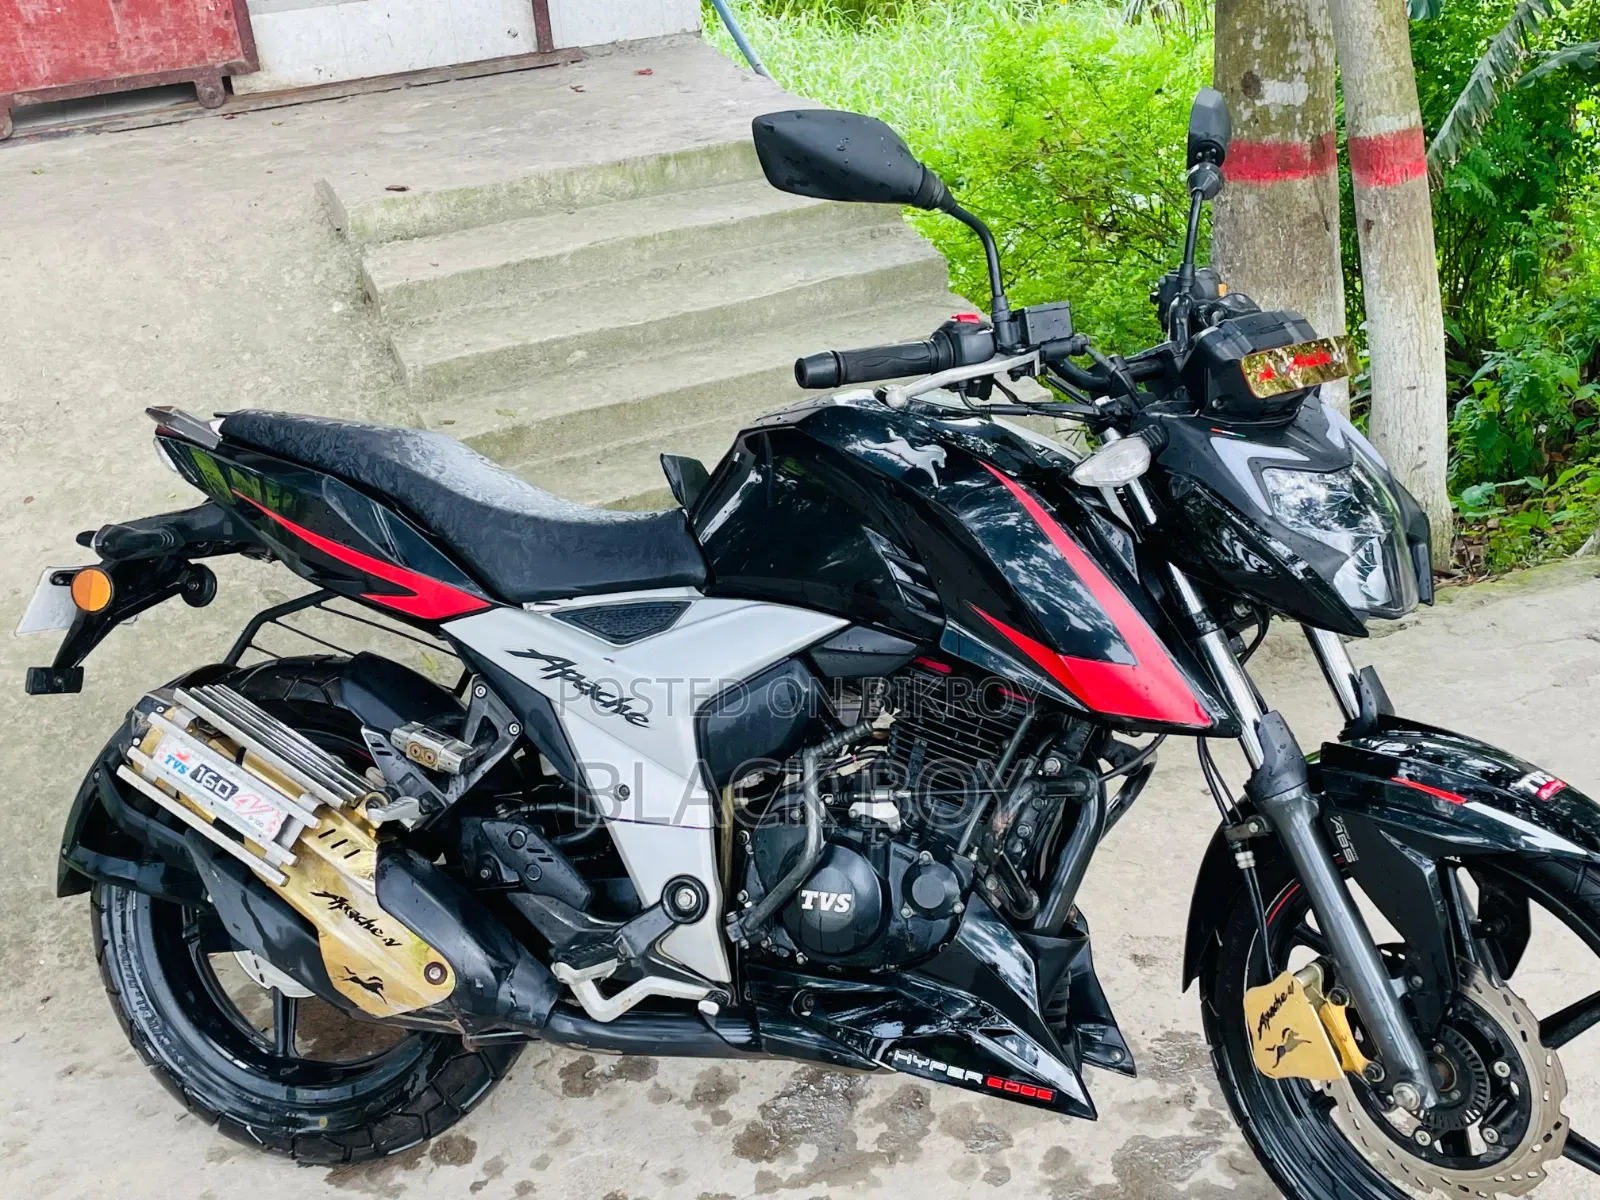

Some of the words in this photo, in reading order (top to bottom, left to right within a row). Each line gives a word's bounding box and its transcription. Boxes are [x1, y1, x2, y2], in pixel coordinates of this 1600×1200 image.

[504, 648, 652, 729] Apache
[164, 754, 190, 775] TVS
[194, 765, 234, 800] 160
[1330, 817, 1356, 863] ABS
[801, 889, 852, 913] TVS
[893, 1049, 984, 1085] HYPER
